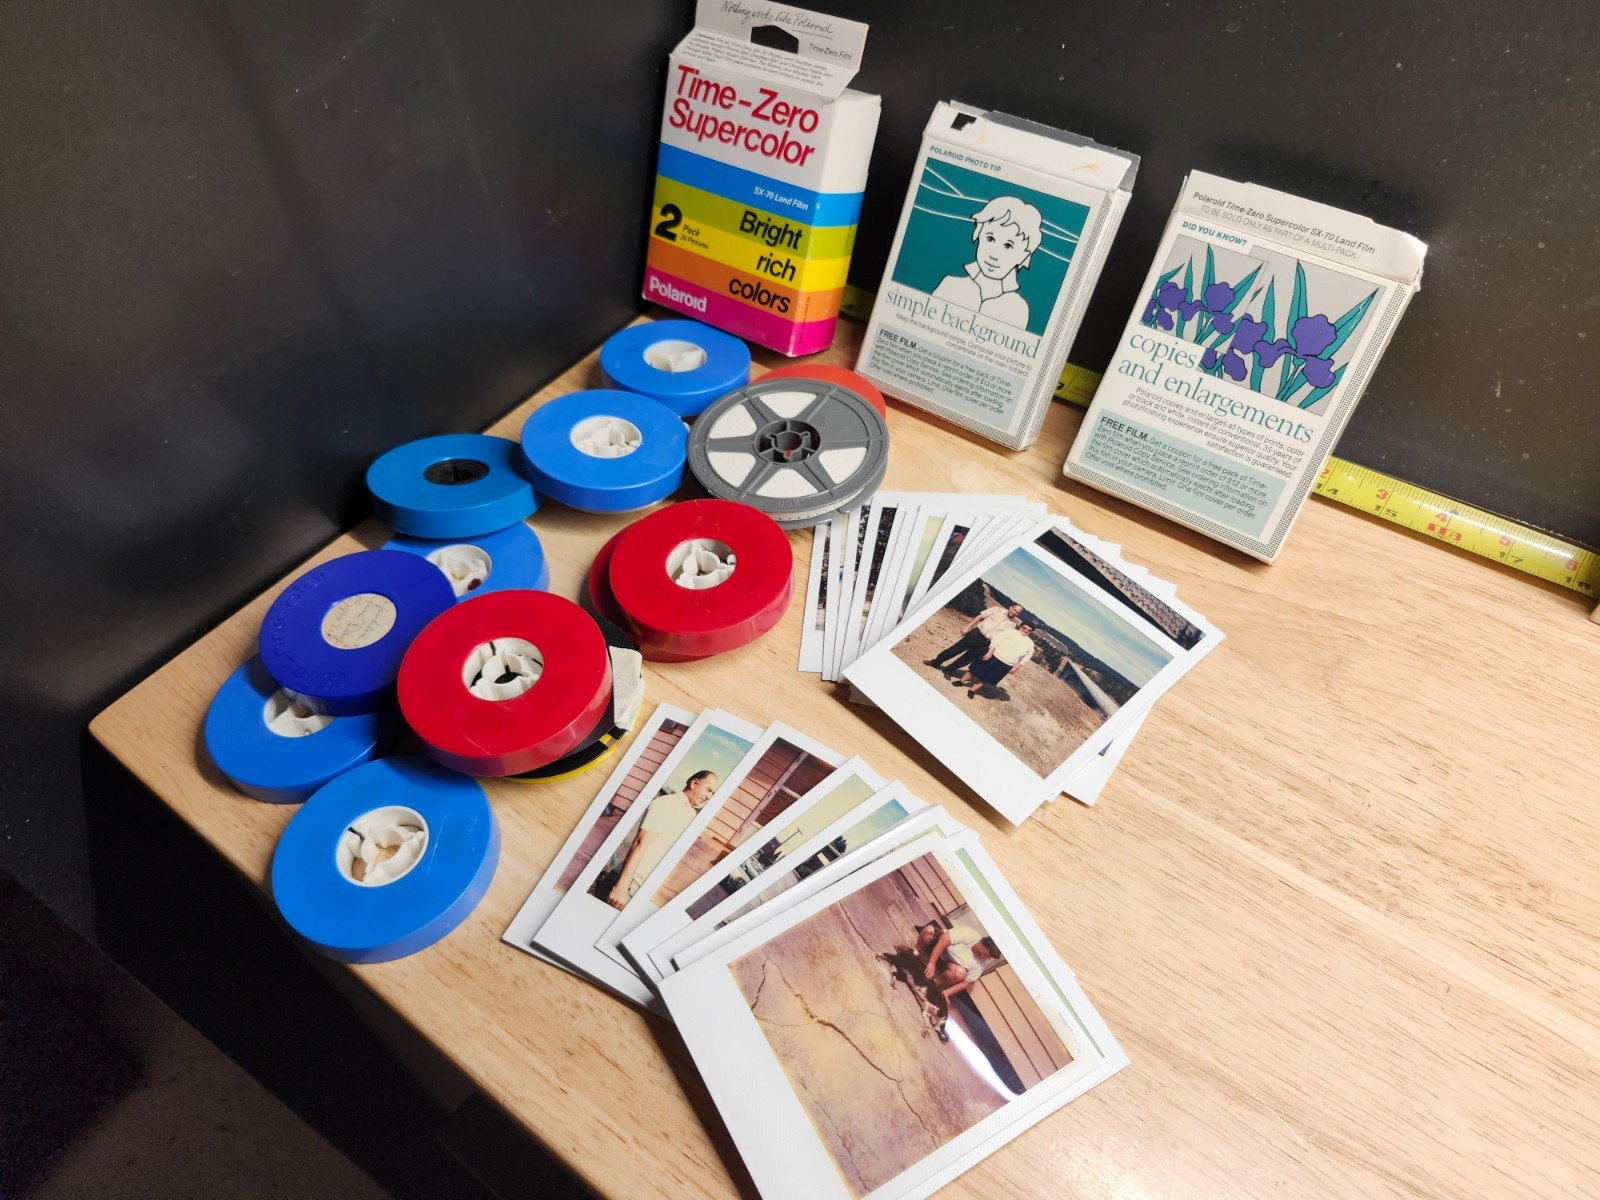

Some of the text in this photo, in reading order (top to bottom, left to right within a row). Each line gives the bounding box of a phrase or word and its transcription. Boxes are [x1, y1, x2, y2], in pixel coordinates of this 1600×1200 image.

[721, 1, 834, 34] Nothing works like Polaroid
[809, 43, 852, 60] Time-Zero Film
[677, 65, 819, 134] Time-Zero
[669, 98, 816, 167] Supercolor
[930, 146, 1002, 172] POLAROID PHOTO TIP
[753, 187, 809, 211] SX-70 Land Film
[655, 203, 701, 243] 2 Pack
[739, 210, 803, 250] Bright
[1182, 221, 1248, 246] DID YOU KNOW?
[1192, 191, 1376, 254] Polaroid Time-Zero Supercolor SX-70 Land Film
[1199, 204, 1211, 213] TO
[1210, 207, 1221, 216] BE
[1221, 210, 1242, 223] SOLD
[1242, 217, 1262, 229] ONLY
[1261, 223, 1273, 232] AS
[1273, 226, 1293, 238] PART
[1292, 232, 1304, 242] OF
[1303, 236, 1311, 244] A
[688, 237, 709, 250] Pictures
[756, 253, 796, 282] rich
[649, 276, 707, 313] Polaroid
[729, 278, 791, 313] colors
[879, 328, 899, 342] FREE
[885, 289, 1042, 359] simple background
[1129, 334, 1198, 369] copies
[1118, 359, 1314, 443] and enlargements
[1122, 398, 1167, 421] photofinishing
[1166, 416, 1204, 435] experience
[1203, 431, 1227, 444] ensure
[1226, 439, 1256, 456] superior
[1280, 460, 1298, 471] Your
[1135, 386, 1163, 402] Polaroid
[1161, 397, 1184, 411] copies
[1184, 405, 1198, 415] and
[1196, 411, 1227, 428] enlarges
[1227, 422, 1236, 430] all
[1235, 426, 1256, 439] types
[1256, 433, 1264, 441] of
[1285, 444, 1305, 457] color
[1135, 395, 1153, 406] black
[1153, 402, 1167, 412] and
[1186, 415, 1209, 428] instant
[1262, 444, 1273, 452] 35
[1271, 449, 1292, 461] years
[1292, 455, 1302, 463] of
[1084, 451, 1101, 463] Offer
[1100, 458, 1115, 468] void
[1114, 464, 1134, 476] where
[1096, 424, 1112, 435] Zero
[1111, 430, 1123, 440] film
[1123, 436, 1142, 447] when
[1141, 444, 1154, 453] you
[1153, 448, 1173, 460] place
[1177, 458, 1200, 472] reprint
[1199, 466, 1218, 478] order
[1218, 473, 1227, 482] of
[1225, 477, 1240, 487] $12
[1247, 487, 1267, 498] more
[1099, 415, 1125, 432] FREE
[1124, 425, 1150, 442] FILM.
[1148, 436, 1162, 447] Get
[1166, 445, 1192, 460] coupon
[1191, 454, 1202, 463] for
[1207, 460, 1222, 471] free
[1221, 467, 1239, 479] pack
[1206, 439, 1245, 459] satisfaction
[1244, 454, 1252, 462] is
[1087, 444, 1099, 453] this
[1099, 449, 1112, 459] film
[1117, 458, 1132, 469] your
[1176, 481, 1192, 492] One
[1191, 488, 1205, 498] film
[1204, 494, 1224, 506] cover
[1223, 502, 1236, 511] per
[1090, 438, 1256, 511] the film cover which automatically ejects after loading
[1093, 431, 1107, 441] with
[1107, 436, 1133, 451] Polaroid
[1132, 447, 1150, 460] Copy
[1177, 465, 1191, 475] See
[1190, 471, 1219, 488] ordering
[1219, 483, 1257, 502] information
[1257, 499, 1267, 507] on
[1316, 483, 1338, 495] 14
[1375, 505, 1398, 517] 15
[1499, 551, 1523, 564] 17
[1565, 576, 1591, 590] 18
[1320, 468, 1579, 571] 2 3 4 5 6
